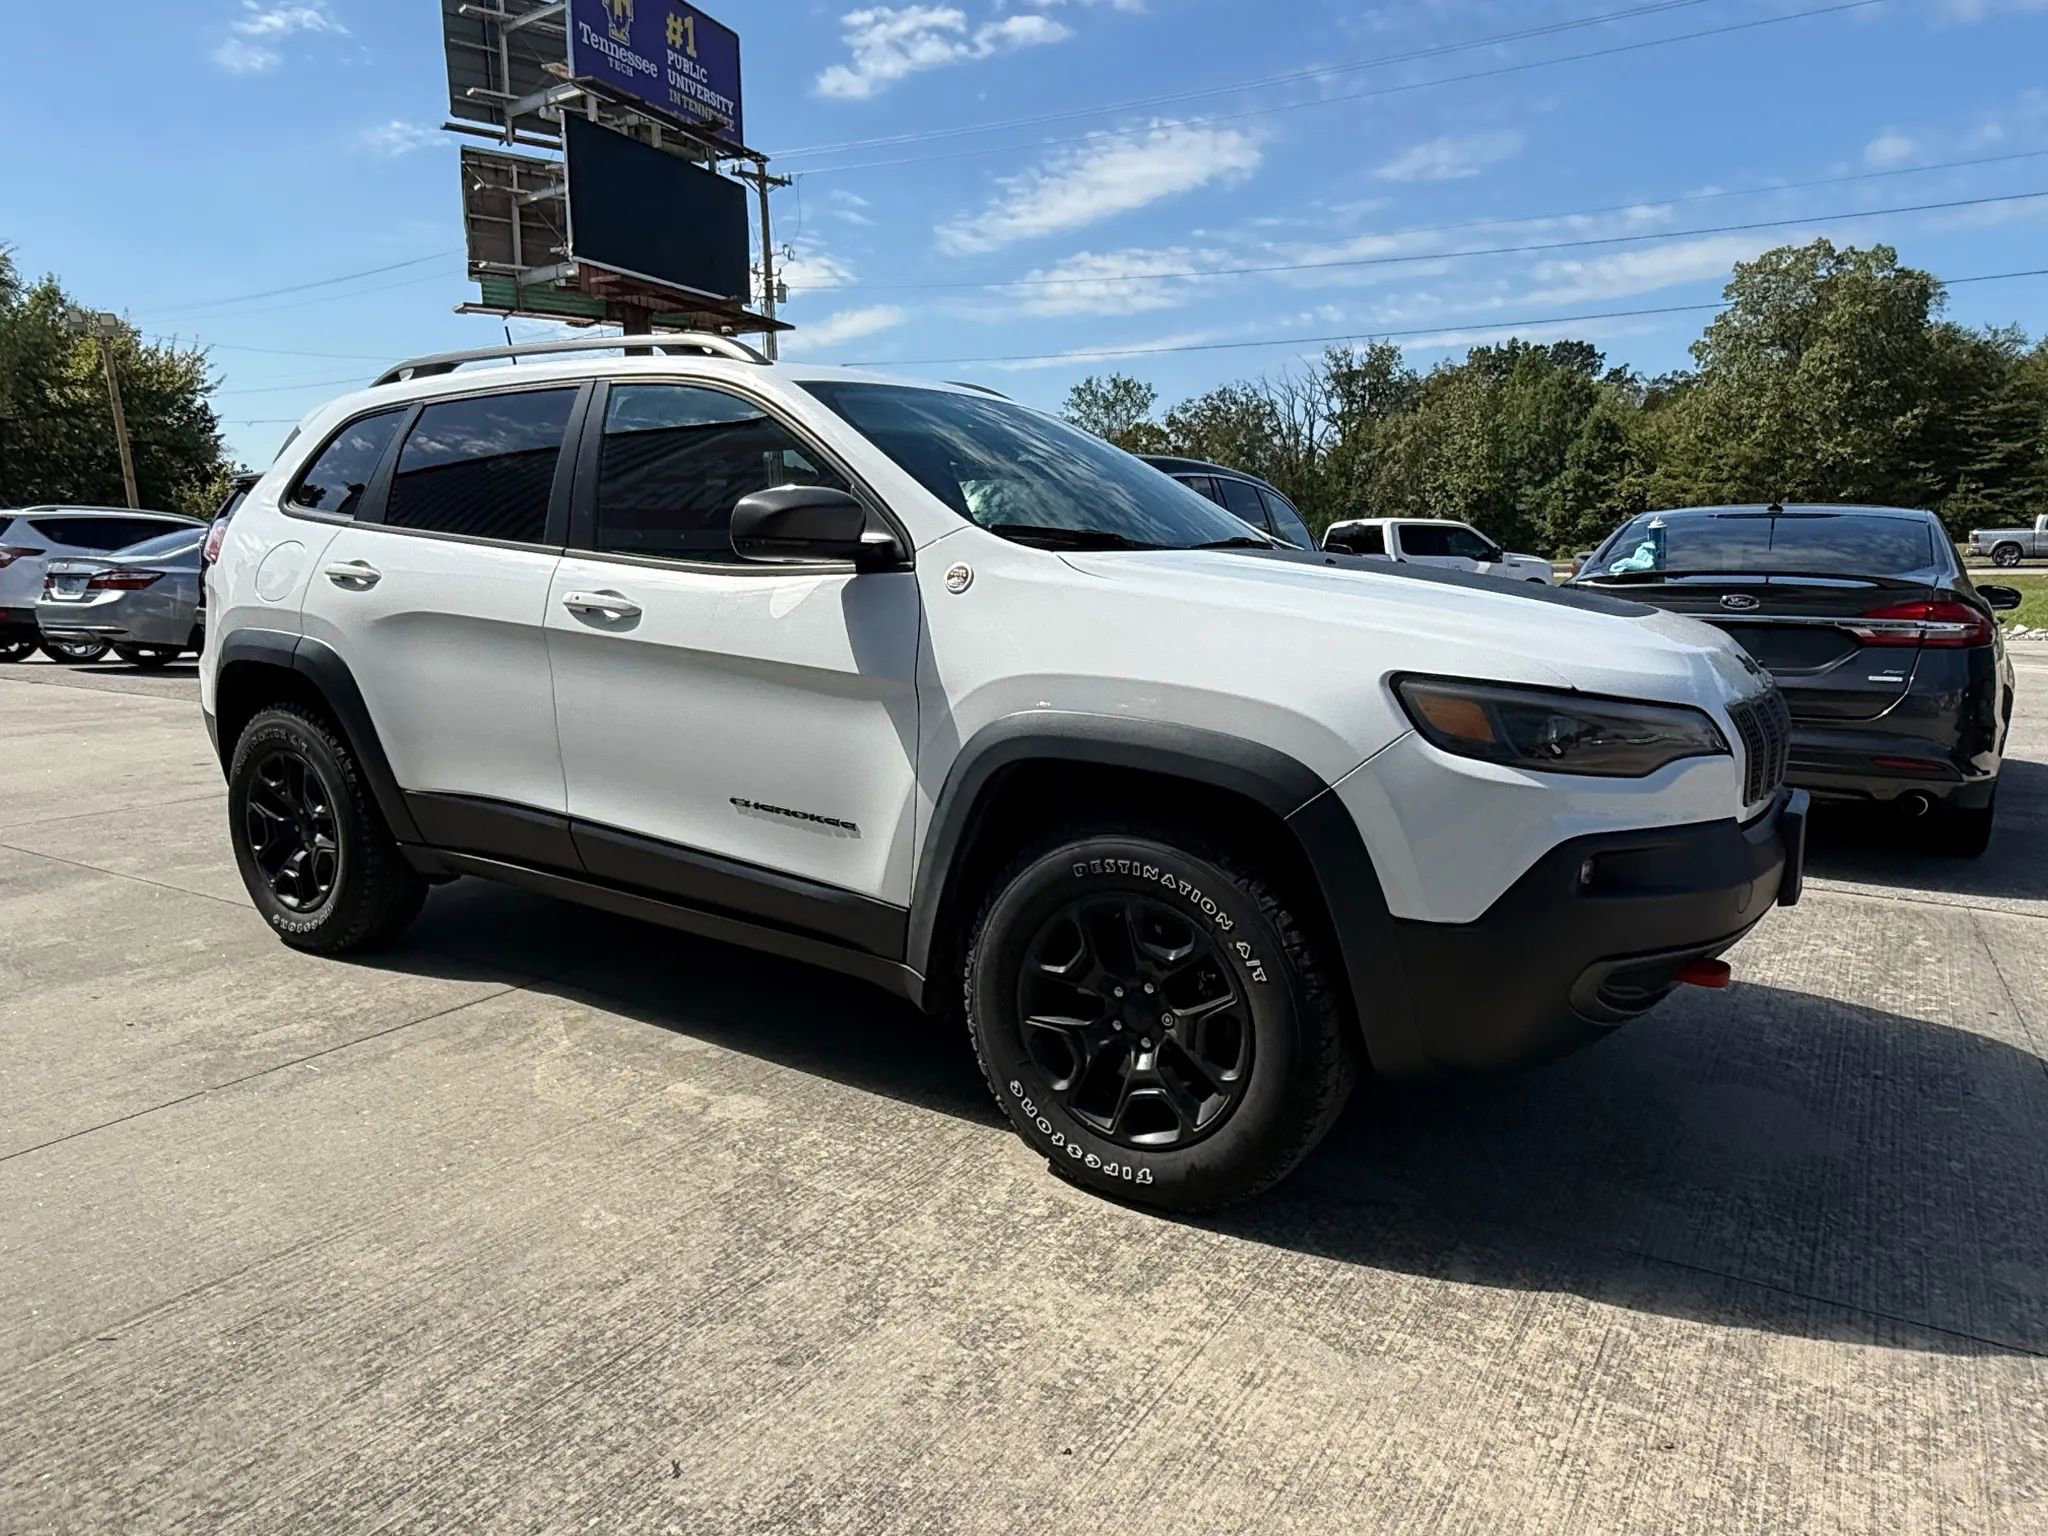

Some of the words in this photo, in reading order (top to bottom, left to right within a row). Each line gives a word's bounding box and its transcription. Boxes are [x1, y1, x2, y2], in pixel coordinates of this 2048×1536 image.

[578, 20, 658, 78] Tennessee
[665, 11, 697, 58] #1
[607, 57, 634, 77] TECH
[666, 49, 708, 83] PUBLIC
[667, 68, 734, 115] UNIVERSITY
[668, 88, 681, 106] IN
[1072, 858, 1234, 931] DESTINATION
[1236, 940, 1268, 983] A/T
